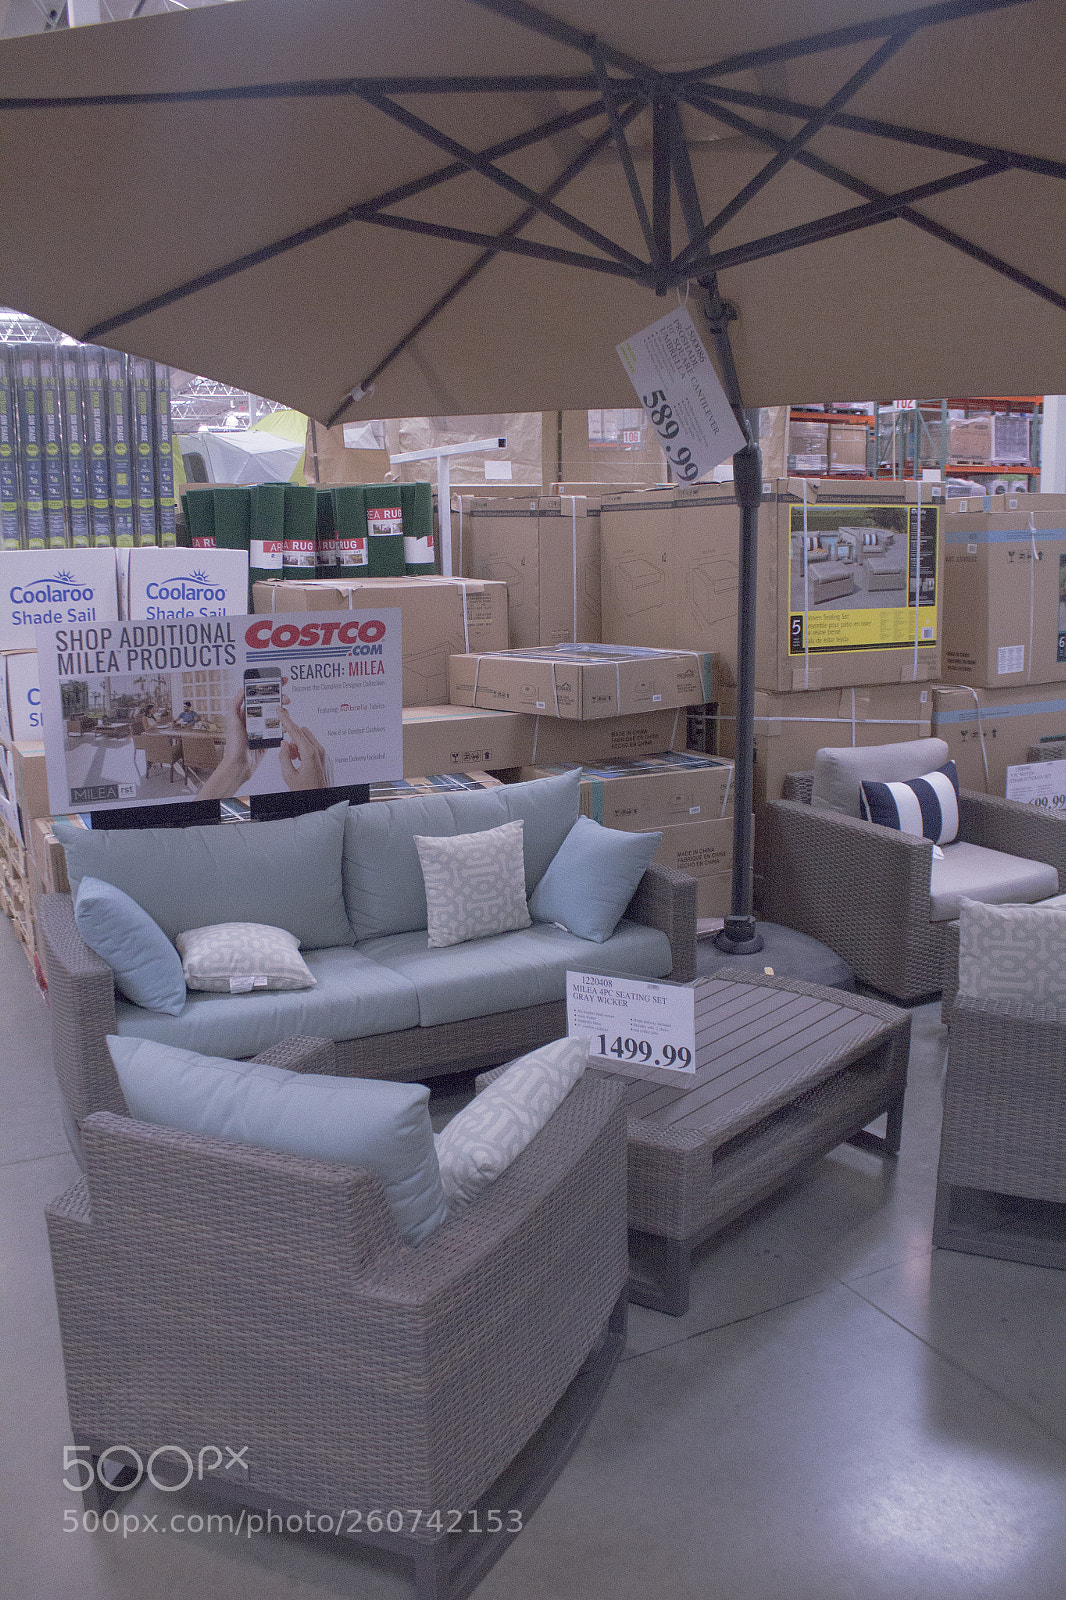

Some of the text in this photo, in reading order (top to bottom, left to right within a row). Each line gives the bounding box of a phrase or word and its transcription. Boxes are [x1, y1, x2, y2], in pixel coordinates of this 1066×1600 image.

[661, 326, 685, 379] UMBRELLA
[673, 319, 699, 368] PROSHADE
[673, 338, 694, 374] SQUARE
[690, 376, 720, 434] CANTILEVER
[643, 390, 699, 482] 589.99
[384, 509, 402, 520] RUG
[292, 540, 314, 552] RUG
[10, 584, 94, 605] Coolaroo
[146, 581, 226, 602] Coolaroo
[12, 607, 97, 626] Shade Sail
[147, 606, 227, 620] Shade Sail
[55, 621, 236, 652] SHOP ADDITIONAL
[245, 620, 386, 649] COSTCO
[792, 619, 801, 635] 5
[1059, 636, 1066, 649] 6
[57, 643, 237, 677] MILEA PRODUCTS
[290, 660, 385, 681] SEARCH: MILEA
[72, 787, 118, 802] MILEA
[581, 976, 613, 988] 1220408
[573, 984, 668, 1005] MILEA 4PC SEATING SET
[573, 993, 629, 1007] GRAY WICKER
[598, 1034, 692, 1069] 1499.99
